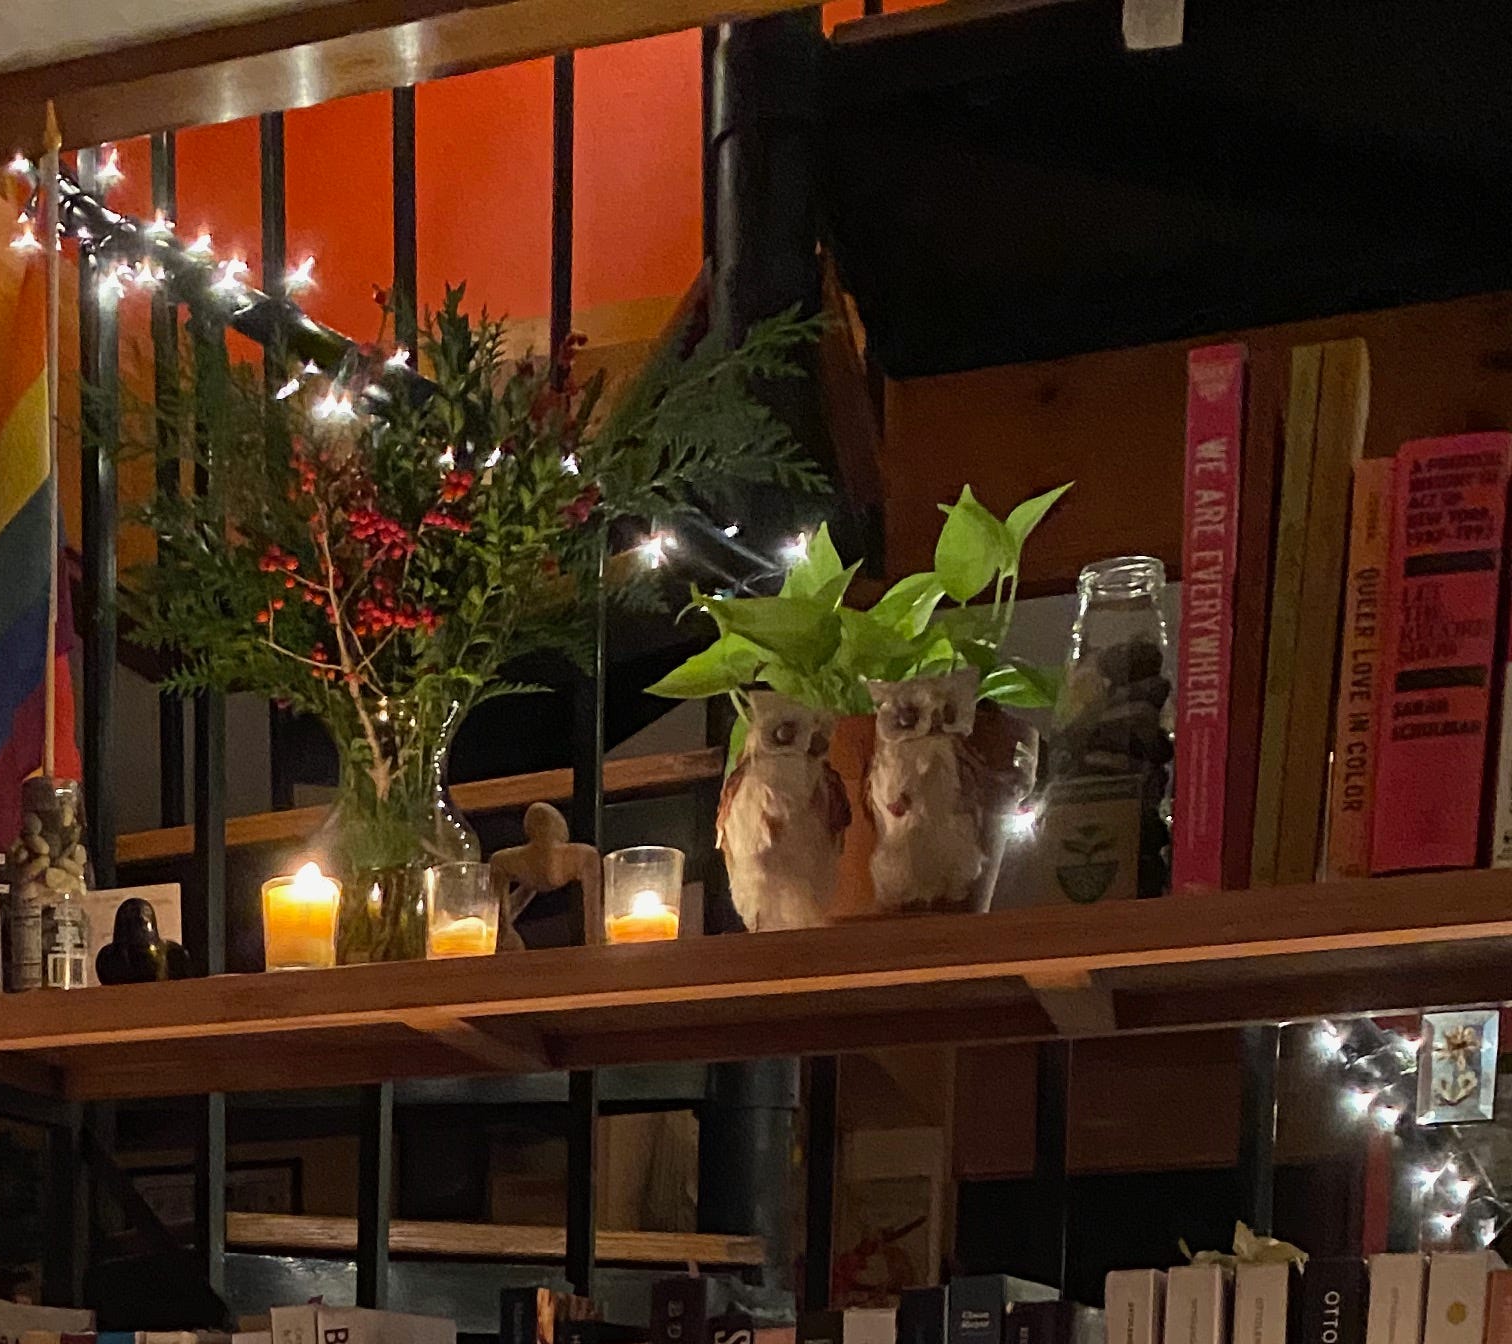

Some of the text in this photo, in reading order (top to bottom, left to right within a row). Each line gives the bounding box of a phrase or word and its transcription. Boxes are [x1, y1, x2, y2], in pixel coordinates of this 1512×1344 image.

[1194, 438, 1228, 475] WE
[1191, 488, 1227, 538] ARE
[1352, 567, 1380, 639] QUEER
[1185, 551, 1225, 723] EVERYWHERE
[1349, 649, 1377, 701] LOVE
[1349, 712, 1371, 733] IN
[1341, 742, 1368, 813] COLOR
